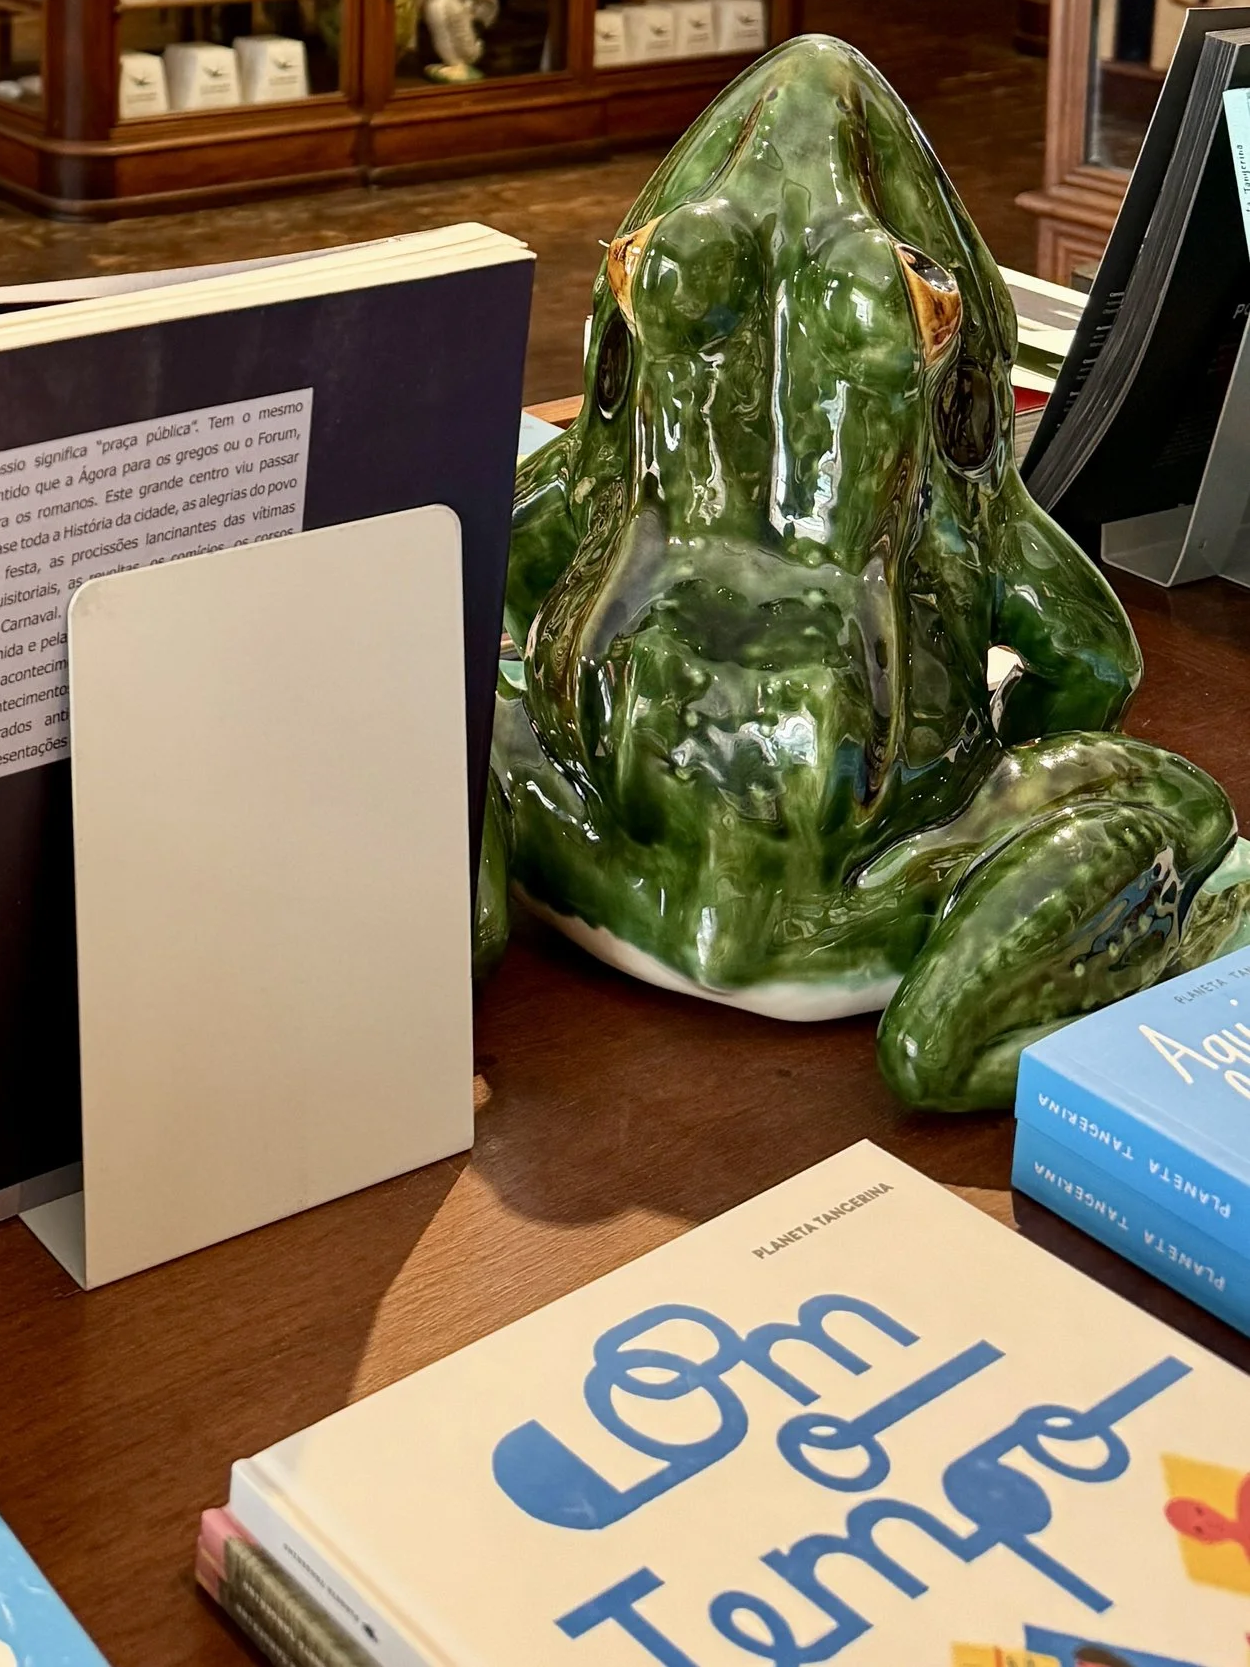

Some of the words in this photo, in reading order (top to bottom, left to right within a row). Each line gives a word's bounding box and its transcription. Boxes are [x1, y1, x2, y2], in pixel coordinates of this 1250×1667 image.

[34, 445, 88, 468] significa
[208, 415, 234, 430] Tem
[242, 412, 251, 423] o
[258, 401, 303, 421] mesmo
[35, 478, 61, 496] que
[65, 475, 73, 486] a
[78, 465, 117, 485] Ágora
[122, 459, 151, 476] para
[156, 453, 171, 467] os
[175, 442, 219, 465] gregos
[223, 440, 240, 453] ou
[244, 437, 253, 448] o
[258, 427, 301, 446] Forum,
[15, 511, 32, 524] os
[37, 495, 98, 520] romanos.
[104, 487, 133, 504] Este
[139, 475, 184, 499] grande
[189, 466, 229, 485] centro
[235, 460, 254, 475] viu
[259, 451, 300, 471] passar
[20, 531, 50, 549] toda
[52, 530, 61, 542] a
[63, 516, 113, 539] História
[115, 513, 132, 528] da
[134, 502, 180, 524] cidade,
[181, 498, 196, 512] as
[198, 487, 248, 508] alegrias
[249, 482, 266, 497] do
[267, 478, 298, 496] povo
[4, 562, 42, 580] festa,
[48, 554, 65, 569] as
[71, 536, 139, 564] procissões
[145, 519, 217, 546] lancinantes
[223, 512, 246, 528] das
[252, 501, 296, 521] vítimas
[67, 576, 84, 590] as
[0, 606, 62, 633] Carnaval.
[28, 639, 37, 652] e
[0, 658, 69, 686] acontecim
[1174, 978, 1228, 1005] PLANETA
[1037, 1092, 1135, 1161] TANGERINA
[751, 1222, 819, 1259] PLANETA
[812, 1182, 895, 1226] TANGERINA
[1033, 1161, 1130, 1231] TANGERINA
[1149, 1158, 1231, 1219] PLANETA
[1143, 1228, 1226, 1292] PLANETA
[553, 1356, 1193, 1667] Tempo
